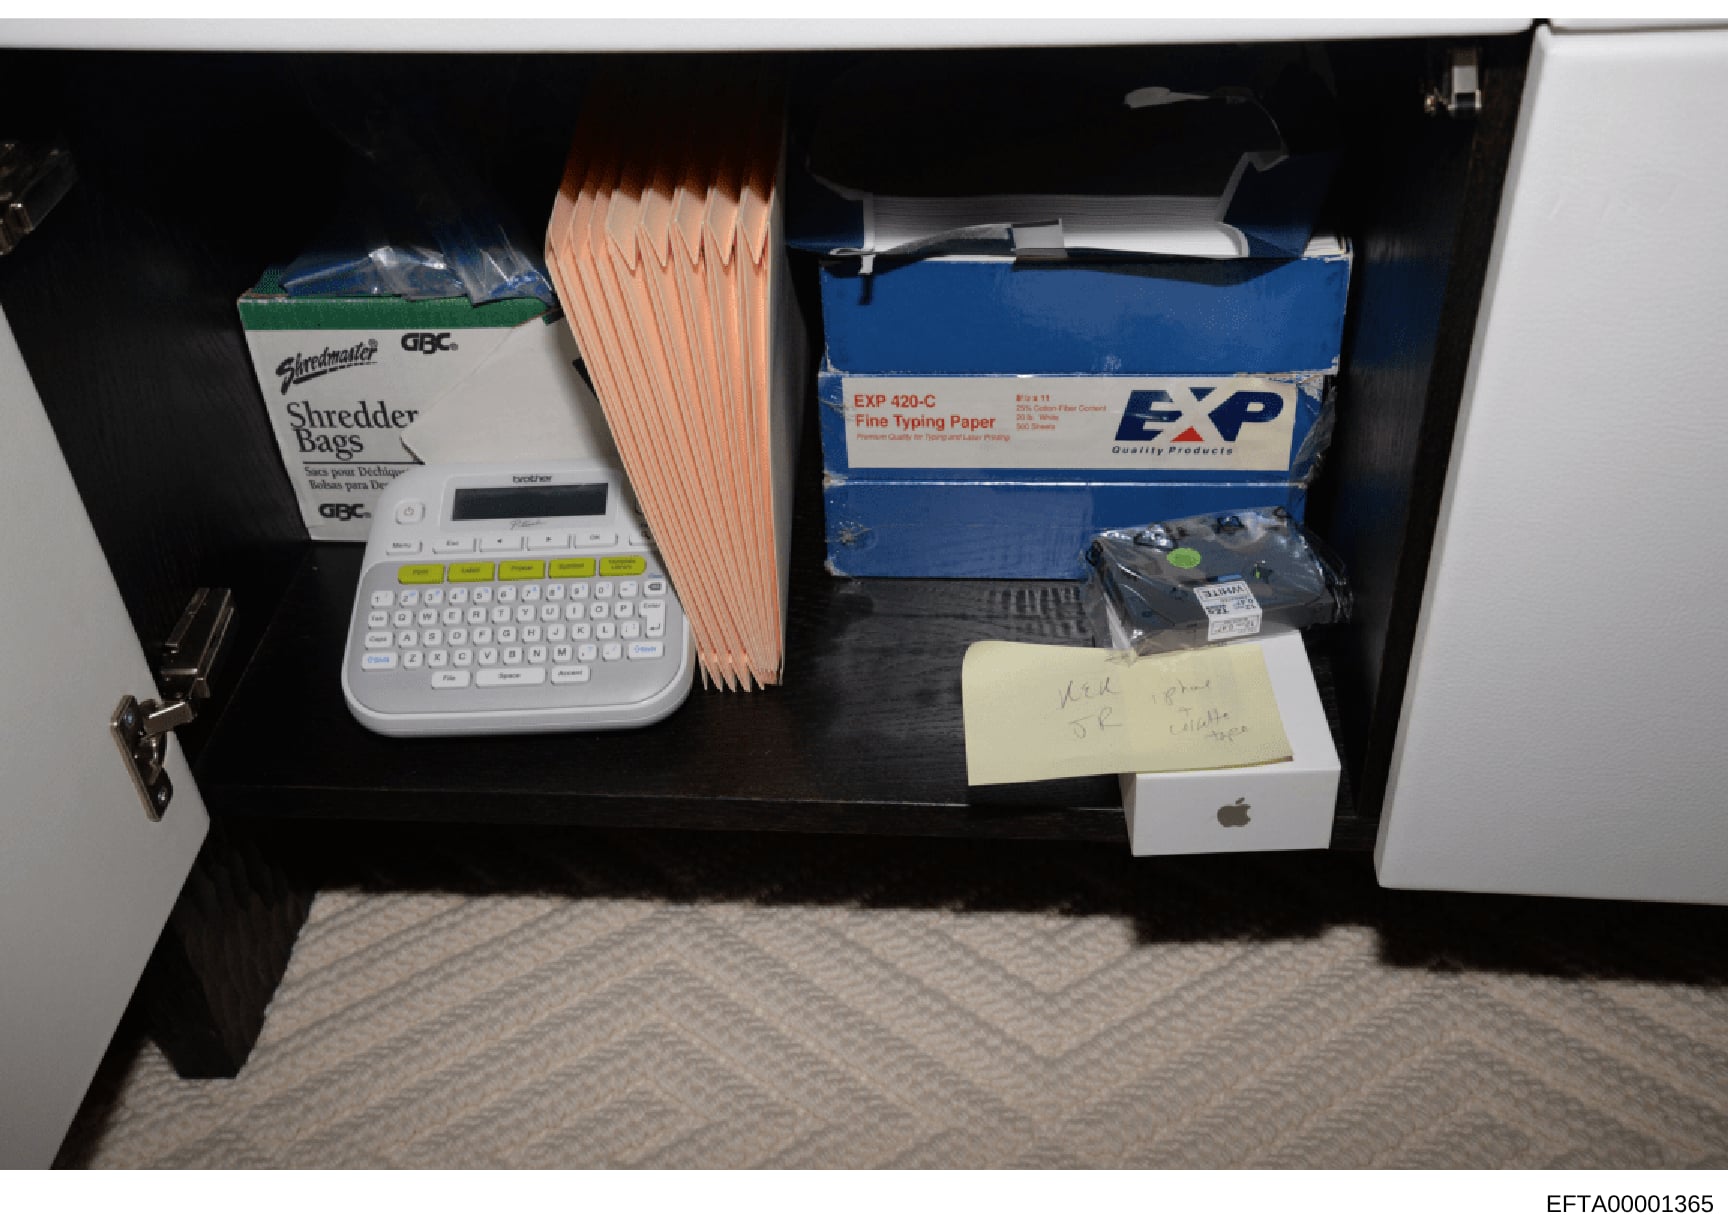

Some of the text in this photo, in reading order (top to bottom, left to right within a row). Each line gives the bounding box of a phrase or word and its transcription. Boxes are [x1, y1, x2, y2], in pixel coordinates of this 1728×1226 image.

[853, 394, 936, 408] EXP 420-C
[1041, 394, 1050, 402] 11
[286, 400, 419, 428] Shredder
[1115, 386, 1284, 443] EXP
[855, 414, 996, 431] Fine Typing Paper
[856, 433, 888, 441] Premium
[888, 433, 912, 442] Quality
[293, 428, 364, 461] Bags
[1112, 446, 1233, 456] Quality Products
[305, 466, 329, 476] Sacs
[331, 469, 356, 479] pour
[512, 475, 552, 483] brother
[309, 480, 342, 489] Bolsas
[345, 482, 368, 492] para
[398, 613, 406, 621] Q
[448, 611, 456, 619] E
[453, 631, 461, 639] D
[502, 629, 511, 637] G
[553, 628, 559, 636] J
[578, 626, 585, 634] K
[409, 654, 417, 662] Z
[533, 649, 541, 657] N
[557, 648, 567, 656] M
